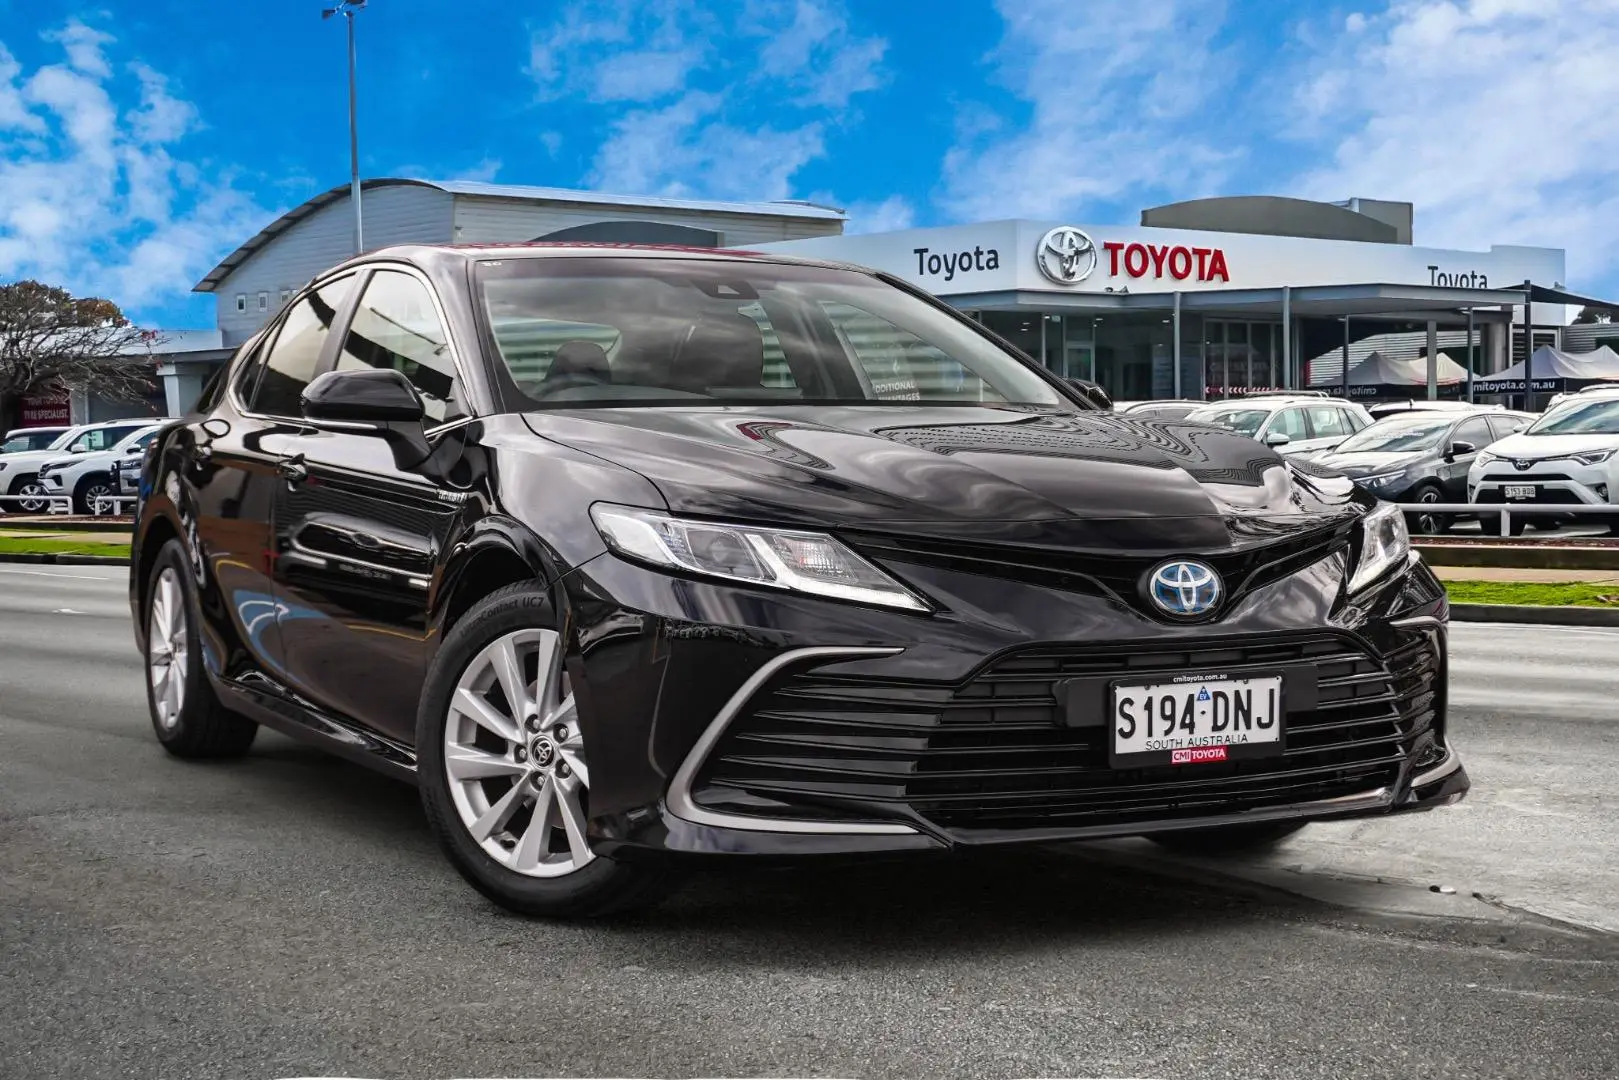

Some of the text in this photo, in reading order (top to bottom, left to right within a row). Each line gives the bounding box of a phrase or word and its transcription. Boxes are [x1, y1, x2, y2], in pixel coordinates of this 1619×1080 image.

[913, 245, 1000, 281] Toyota
[1103, 241, 1230, 282] TOYOTA
[872, 380, 916, 393] DDITIONAL
[1473, 381, 1555, 393] mitoyota.cm.au
[523, 596, 545, 608] UC7
[1173, 674, 1228, 684] cmitoyota.com.au
[1145, 733, 1249, 750] SOUTH AUSTRALIA
[1173, 748, 1226, 762] CMI TOYOTA
